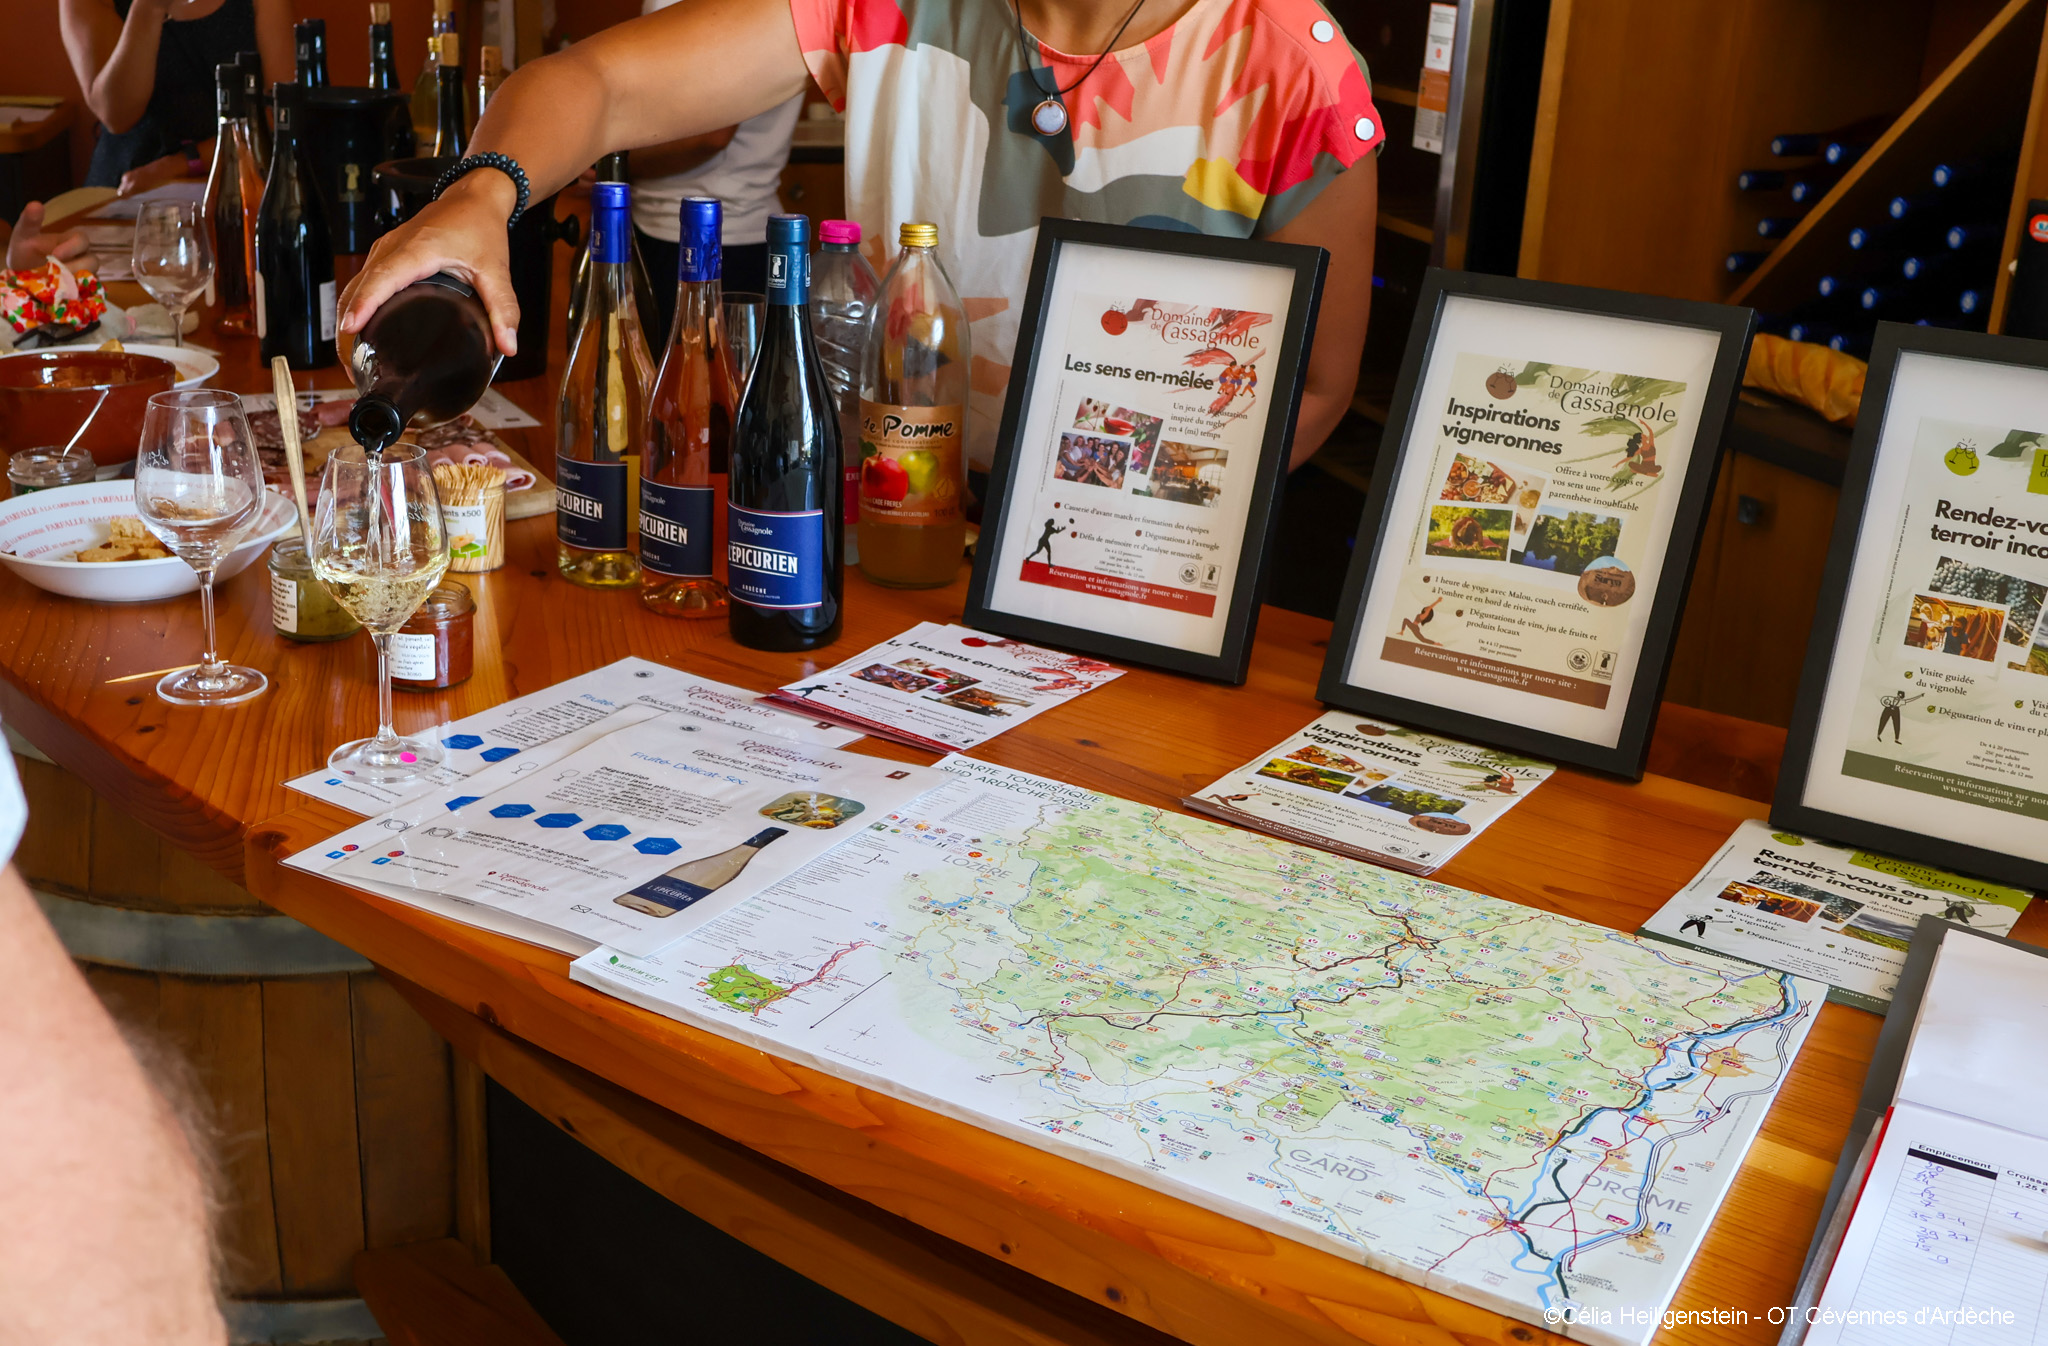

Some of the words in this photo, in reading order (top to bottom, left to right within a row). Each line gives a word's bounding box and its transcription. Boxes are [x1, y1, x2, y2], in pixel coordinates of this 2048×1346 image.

[1151, 308, 1211, 327] Domaine
[1161, 321, 1260, 349] Cassagnole
[1065, 354, 1091, 373] Les
[1096, 364, 1131, 380] sens
[1135, 369, 1214, 391] en-mêlée
[1550, 375, 1620, 398] Domaine
[1173, 402, 1184, 411] Un
[1447, 397, 1561, 433] Inspirations
[1548, 390, 1560, 399] de
[1560, 390, 1676, 423] Cassagnole
[863, 417, 877, 434] de
[883, 415, 954, 438] Pomme
[1170, 413, 1194, 426] inspiré
[1195, 416, 1204, 424] du
[1206, 418, 1226, 430] rugby
[1200, 429, 1221, 440] temps
[1442, 422, 1563, 455] vigneronnes
[1555, 465, 1581, 478] Offrez
[1589, 473, 1610, 483] votre
[1611, 475, 1634, 487] corps
[1635, 479, 1644, 487] et
[1567, 482, 1584, 490] sens
[1585, 484, 1601, 493] une
[461, 509, 481, 517] x500
[1548, 490, 1592, 505] parenthèse
[1593, 495, 1640, 512] inoubliable
[5, 507, 39, 524] FARFALLE
[45, 517, 87, 532] FARFALLE
[1064, 503, 1090, 514] Causerie
[1093, 507, 1113, 518] d'avant
[1114, 512, 1133, 522] match
[1141, 516, 1173, 529] formation
[1186, 524, 1210, 535] équipes
[740, 523, 773, 535] Cassagnole
[1145, 531, 1185, 545] Dégustations
[1192, 538, 1220, 551] l'aveugle
[1930, 524, 2003, 550] terroir
[2006, 534, 2048, 559] inco
[1079, 532, 1095, 543] Défis
[1105, 537, 1132, 550] mémoire
[1141, 543, 1169, 557] d'analyse
[1171, 549, 1203, 561] sensorielle
[1048, 568, 1087, 582] Réservation
[1096, 576, 1139, 592] informations
[1152, 588, 1171, 598] notre
[1172, 591, 1184, 600] site
[1085, 581, 1148, 600] www.cassagnole.fr
[1440, 576, 1460, 589] heure
[1462, 581, 1470, 590] de
[1471, 584, 1489, 594] yoga
[1490, 587, 1507, 596] avec
[1508, 588, 1533, 604] Malou,
[1535, 595, 1556, 606] coach
[1557, 599, 1590, 614] certifiée,
[1437, 587, 1464, 600] l'ombre
[1474, 595, 1483, 603] en
[1484, 595, 1502, 609] bord
[1503, 600, 1511, 609] de
[1513, 602, 1537, 614] rivière
[1466, 619, 1496, 633] produits
[1497, 625, 1521, 637] locaux
[1469, 607, 1516, 625] Dégustations
[1517, 616, 1526, 625] de
[1527, 619, 1545, 631] vins,
[1557, 625, 1567, 634] de
[1568, 627, 1588, 640] fruits
[1589, 633, 1597, 641] et
[909, 641, 934, 652] Les
[935, 648, 970, 663] sens
[972, 659, 1047, 683] en-mêlée
[1413, 646, 1459, 664] Réservation
[1460, 657, 1468, 665] et
[1469, 659, 1520, 677] informations
[1534, 674, 1556, 685] notre
[1558, 678, 1572, 689] site
[1456, 664, 1529, 687] www.cassagnole.fr
[1916, 679, 1927, 688] du
[1929, 681, 1968, 696] vignoble
[1919, 666, 1943, 679] Visite
[1945, 672, 1975, 685] guidée
[688, 691, 776, 718] Cassagnole
[690, 709, 726, 723] Rouge
[2029, 707, 2040, 717] du
[1938, 706, 1992, 725] Dégustation
[1994, 718, 2005, 728] de
[2007, 721, 2025, 732] vins
[1302, 731, 1421, 768] vigneronnes
[1310, 723, 1424, 759] Inspirations
[692, 749, 750, 768] Epicurien
[751, 764, 788, 776] Blanc
[787, 772, 821, 783] 2024
[743, 745, 842, 771] Cassagnole
[723, 775, 749, 786] Sec
[940, 764, 974, 779] SUD
[974, 774, 1053, 801] ARDÈCHE
[1049, 796, 1093, 812] 2025
[952, 758, 1004, 776] CARTE
[1006, 772, 1102, 804] TOURISTIQUE
[1894, 764, 1944, 783] Réservation
[1946, 777, 1956, 785] et
[1956, 778, 2013, 798] informations
[1942, 783, 2025, 808] www.cassagnole.fr
[941, 854, 1013, 880] LOZÈRE
[1758, 848, 1898, 893] Rendez-vous
[1901, 887, 1930, 901] en
[1873, 860, 1999, 900] Cassagnole
[1752, 855, 1824, 881] terroir
[1825, 875, 1914, 906] inconnu
[1289, 1149, 1369, 1183] GARD
[1918, 1144, 1992, 1170] Emplacement
[2007, 1170, 2048, 1186] Croissa
[1581, 1173, 1693, 1215] DRÔME
